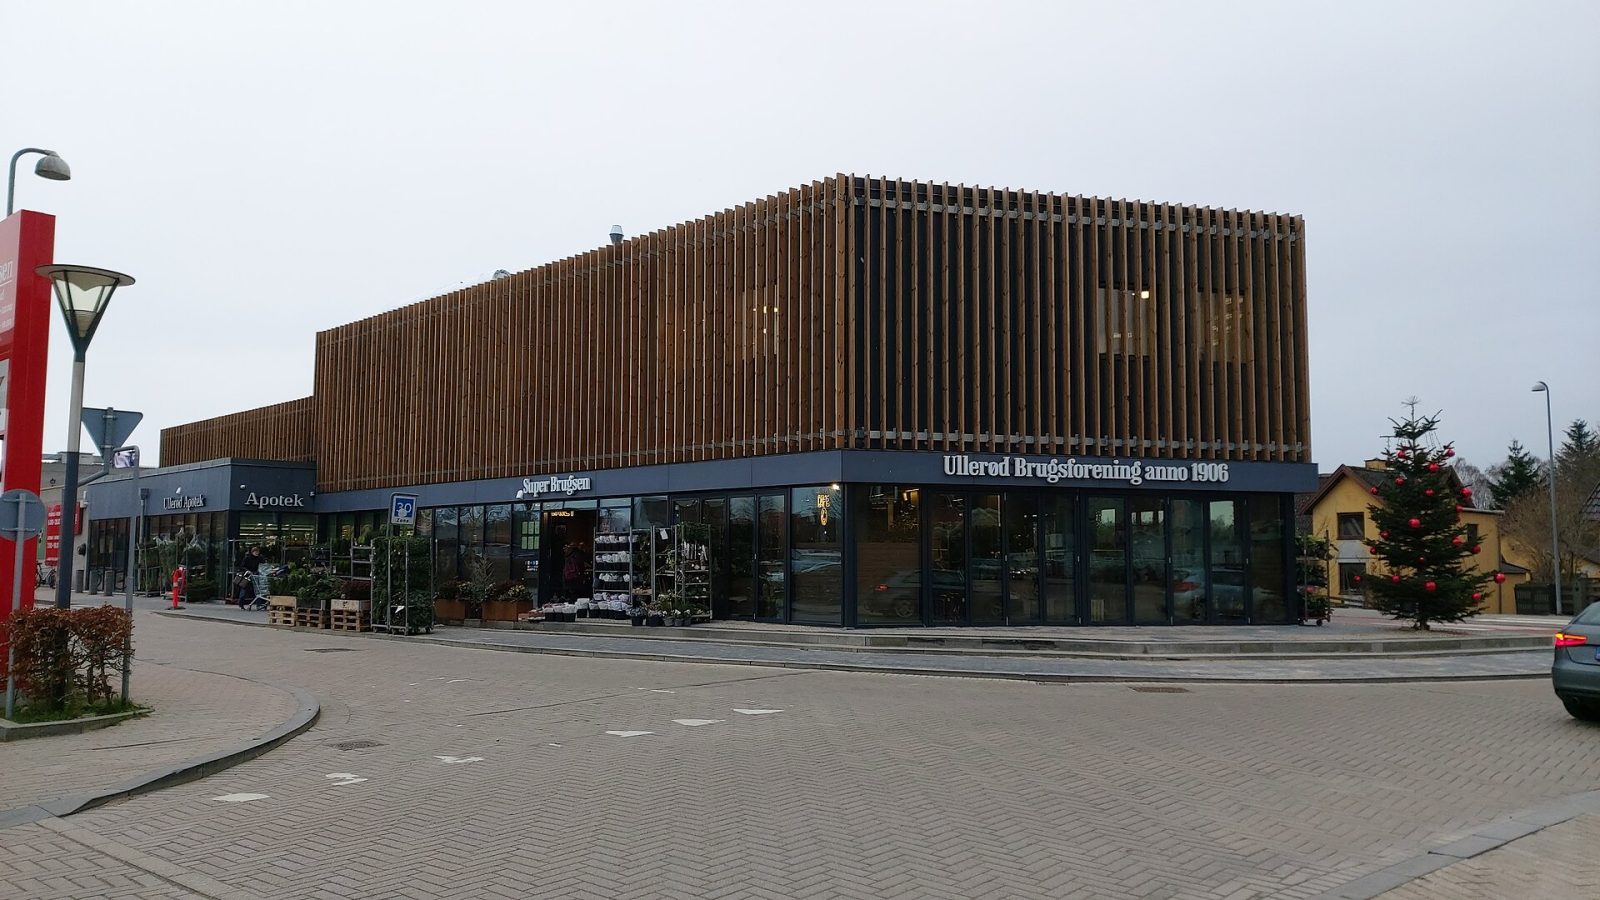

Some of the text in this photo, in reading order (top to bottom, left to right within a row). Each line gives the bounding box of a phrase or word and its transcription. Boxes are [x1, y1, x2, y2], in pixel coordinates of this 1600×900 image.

[943, 455, 1229, 485] Ullerød Brugsforening anno 1906
[183, 493, 204, 511] Apotek
[244, 492, 304, 509] Apotek
[396, 502, 412, 513] 30
